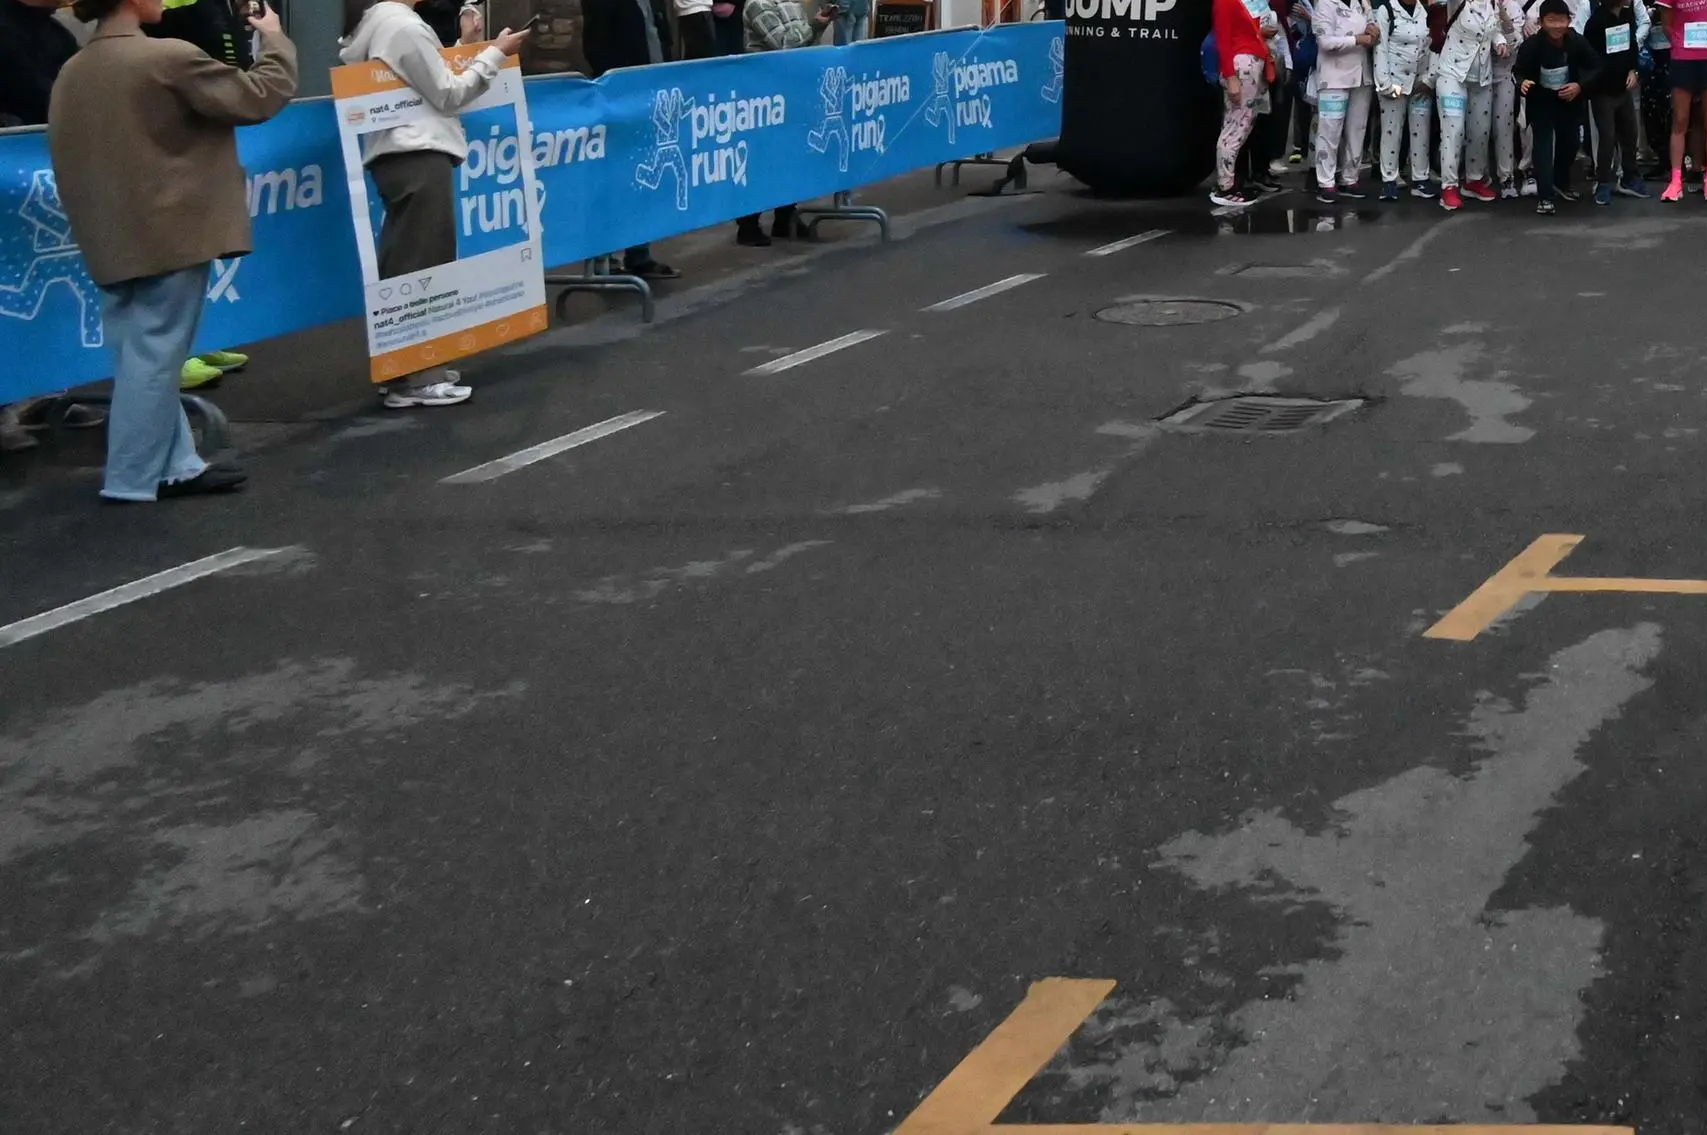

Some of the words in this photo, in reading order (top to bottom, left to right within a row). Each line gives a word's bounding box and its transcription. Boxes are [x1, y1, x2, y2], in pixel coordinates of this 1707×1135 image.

[1111, 27, 1121, 38] &
[1128, 27, 1179, 40] TRAIL
[852, 70, 911, 120] pigiama
[954, 55, 1019, 98] pigiama
[369, 97, 424, 115] nat4_official
[691, 90, 785, 150] pigiama
[956, 100, 983, 128] run
[851, 121, 878, 153] run
[691, 145, 736, 187] run
[460, 187, 526, 237] run
[373, 308, 427, 330] nat4_official
